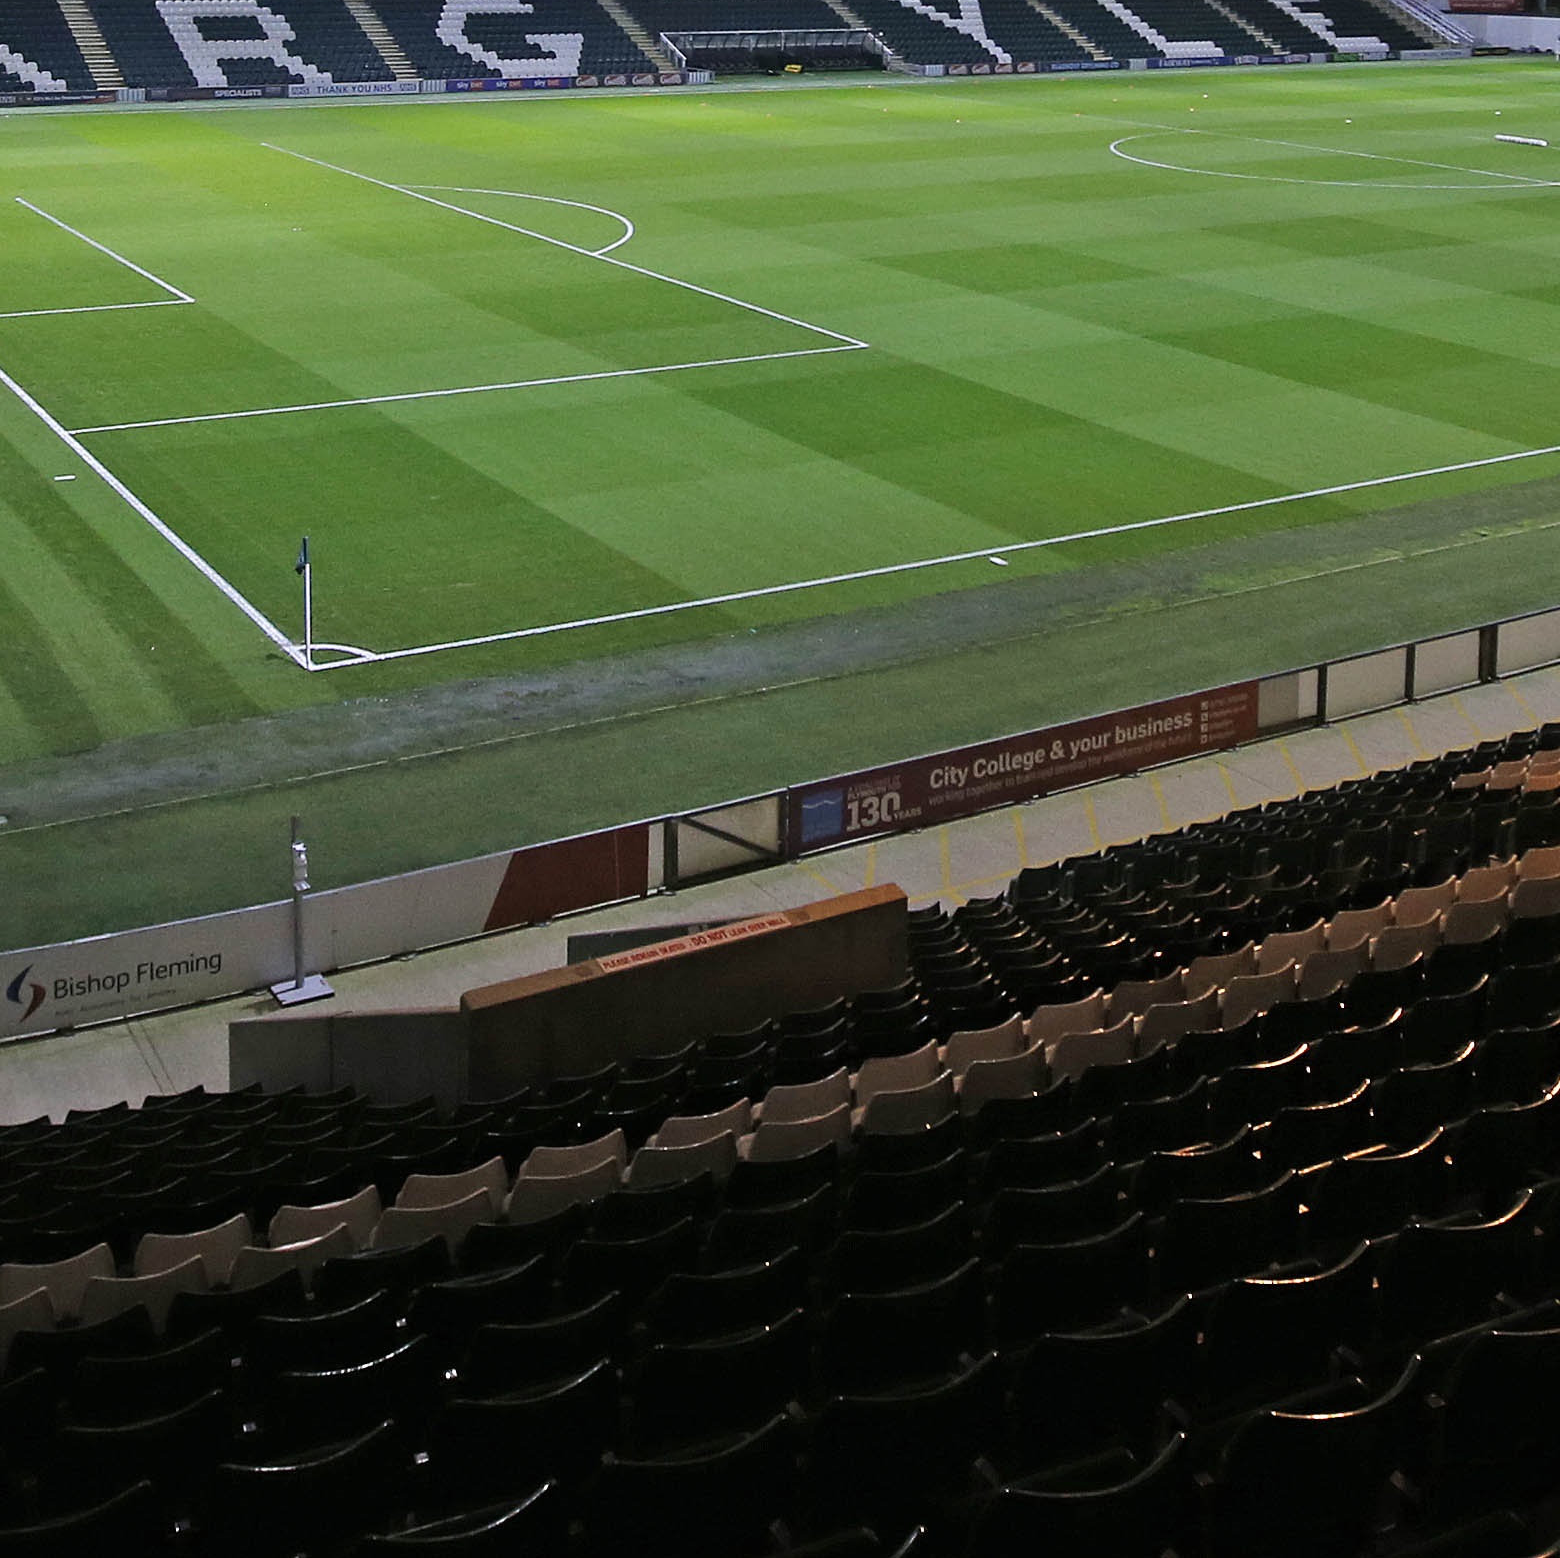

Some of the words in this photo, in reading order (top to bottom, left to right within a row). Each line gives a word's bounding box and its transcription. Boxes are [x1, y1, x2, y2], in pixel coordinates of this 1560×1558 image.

[317, 84, 348, 94] THANK
[350, 84, 371, 93] YOU
[373, 83, 393, 92] NHS
[457, 80, 470, 90] sky
[495, 79, 508, 89] sky
[533, 78, 546, 88] sky
[930, 765, 968, 788] City
[973, 748, 1046, 779] College
[1050, 740, 1065, 760] &
[1070, 732, 1111, 759] your
[1115, 712, 1193, 744] business
[846, 792, 901, 832] 130
[691, 935, 708, 946] DO
[707, 929, 730, 942] NOT
[53, 975, 131, 1000] Bishop
[136, 953, 223, 985] Fleming
